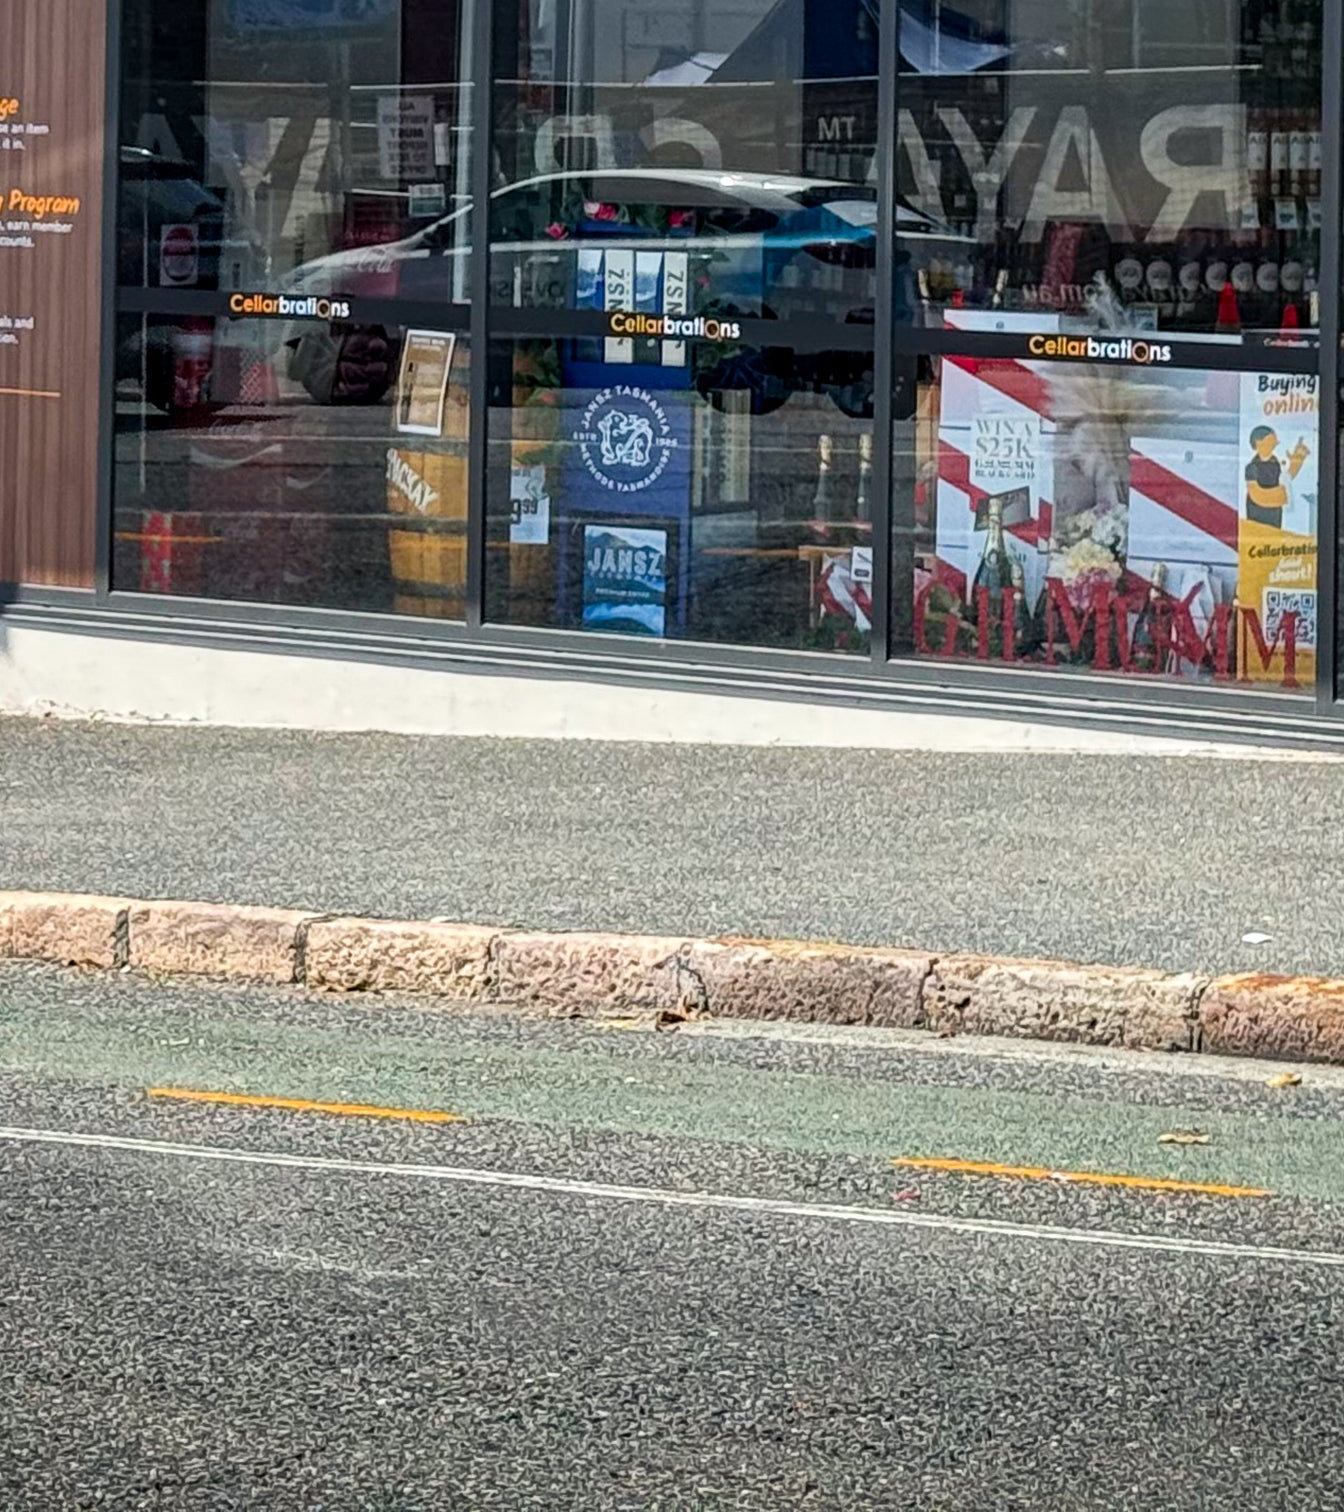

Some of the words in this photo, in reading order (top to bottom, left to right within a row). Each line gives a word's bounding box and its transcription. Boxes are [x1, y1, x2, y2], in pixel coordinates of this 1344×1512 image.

[11, 123, 23, 134] an
[26, 123, 48, 135] item
[9, 190, 79, 217] Program
[32, 221, 72, 233] member
[230, 294, 350, 319] Cellarbrations
[15, 315, 33, 328] and
[610, 313, 741, 340] Cellarbrations
[1028, 335, 1172, 364] Cellarbrations
[1258, 374, 1316, 396] Buying
[581, 389, 612, 429] JANSZ
[615, 385, 670, 435] TASMANIA
[1263, 392, 1317, 416] onlin
[976, 419, 1015, 435] WIN
[976, 437, 1034, 459] $25K
[587, 547, 662, 576] JANSZ
[1248, 543, 1318, 558] Cellarbratio
